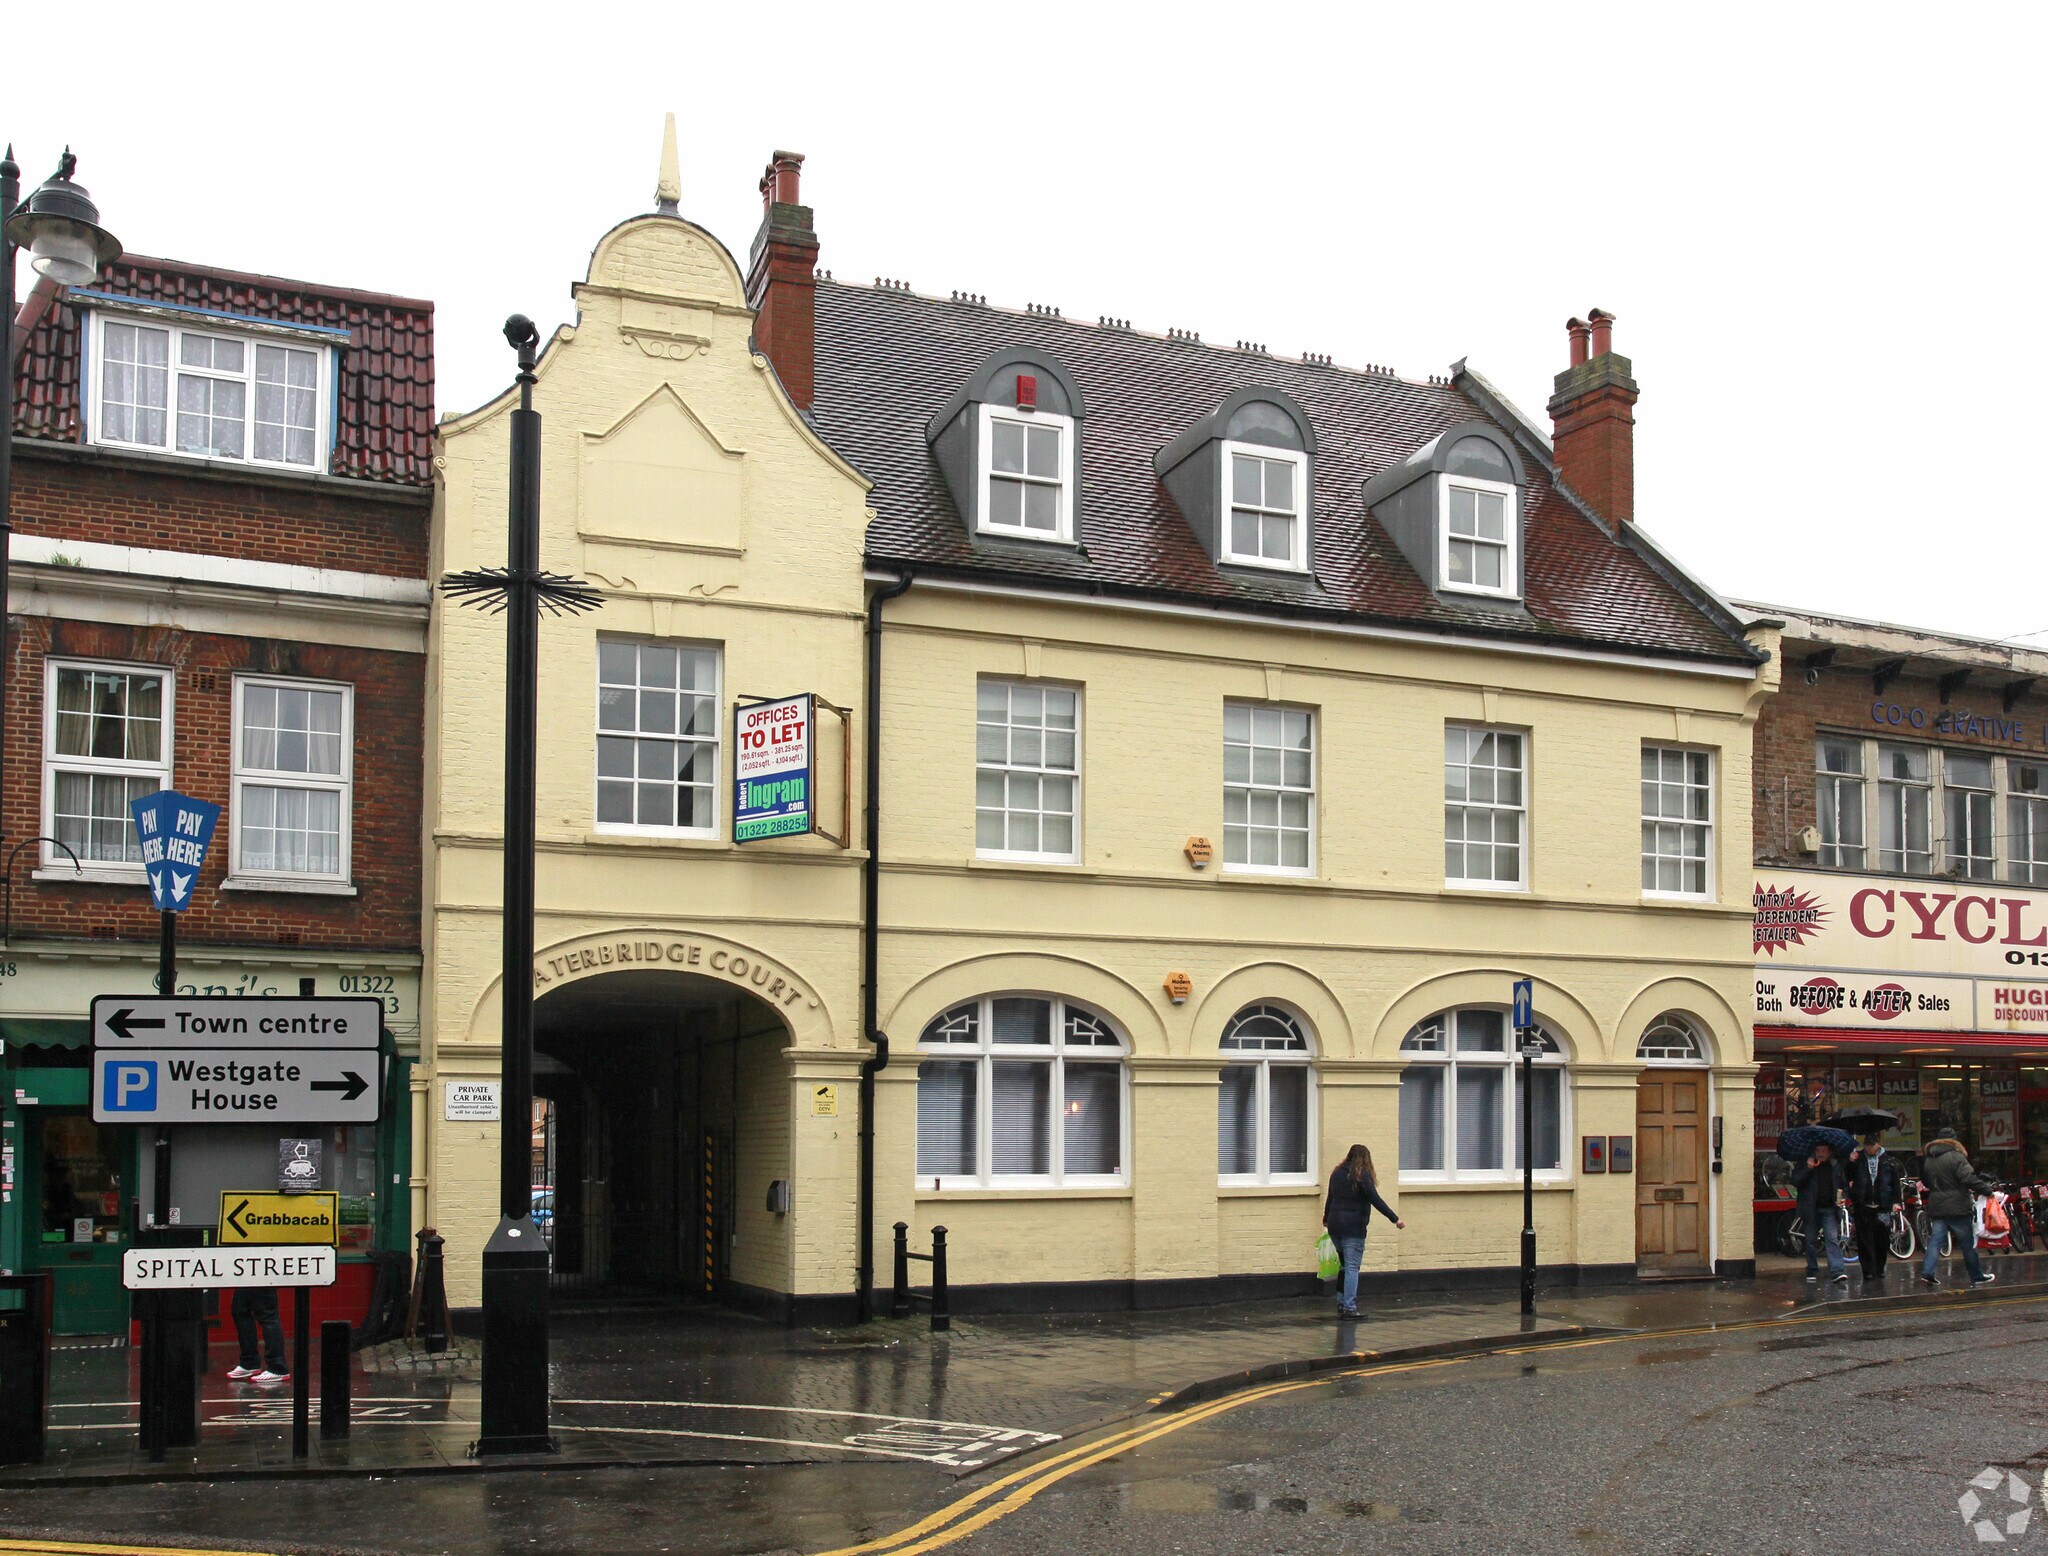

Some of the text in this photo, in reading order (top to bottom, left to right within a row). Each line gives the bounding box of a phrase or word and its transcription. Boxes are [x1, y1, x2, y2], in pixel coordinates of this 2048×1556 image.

[747, 705, 798, 728] OFFICES
[1872, 702, 2024, 742] CO-OERATIVE
[741, 721, 805, 750] TO LET
[739, 782, 747, 810] Robert
[748, 778, 805, 809] Ingram
[786, 801, 805, 812] .com
[141, 808, 157, 835] PAY
[176, 809, 203, 837] PAY
[738, 816, 807, 838] 01322 288254
[142, 837, 164, 865] HERE
[166, 837, 203, 867] HERE
[1850, 888, 2048, 947] CYCL
[339, 975, 394, 993] 01322
[710, 950, 802, 1006] COURT
[1755, 981, 1776, 996] Our
[1756, 997, 1782, 1012] Both
[1789, 985, 1950, 1013] BEFORE & AFTER Sales
[174, 1012, 348, 1034] Town centre
[168, 1061, 301, 1082] Westgate
[118, 1067, 150, 1106] P
[1839, 1079, 1874, 1093] SALE
[1883, 1080, 1917, 1094] SALE
[1983, 1081, 2015, 1095] SALE
[191, 1089, 278, 1110] House
[245, 1213, 330, 1226] Grabbacab
[137, 1256, 326, 1279] SPITAL STREET
